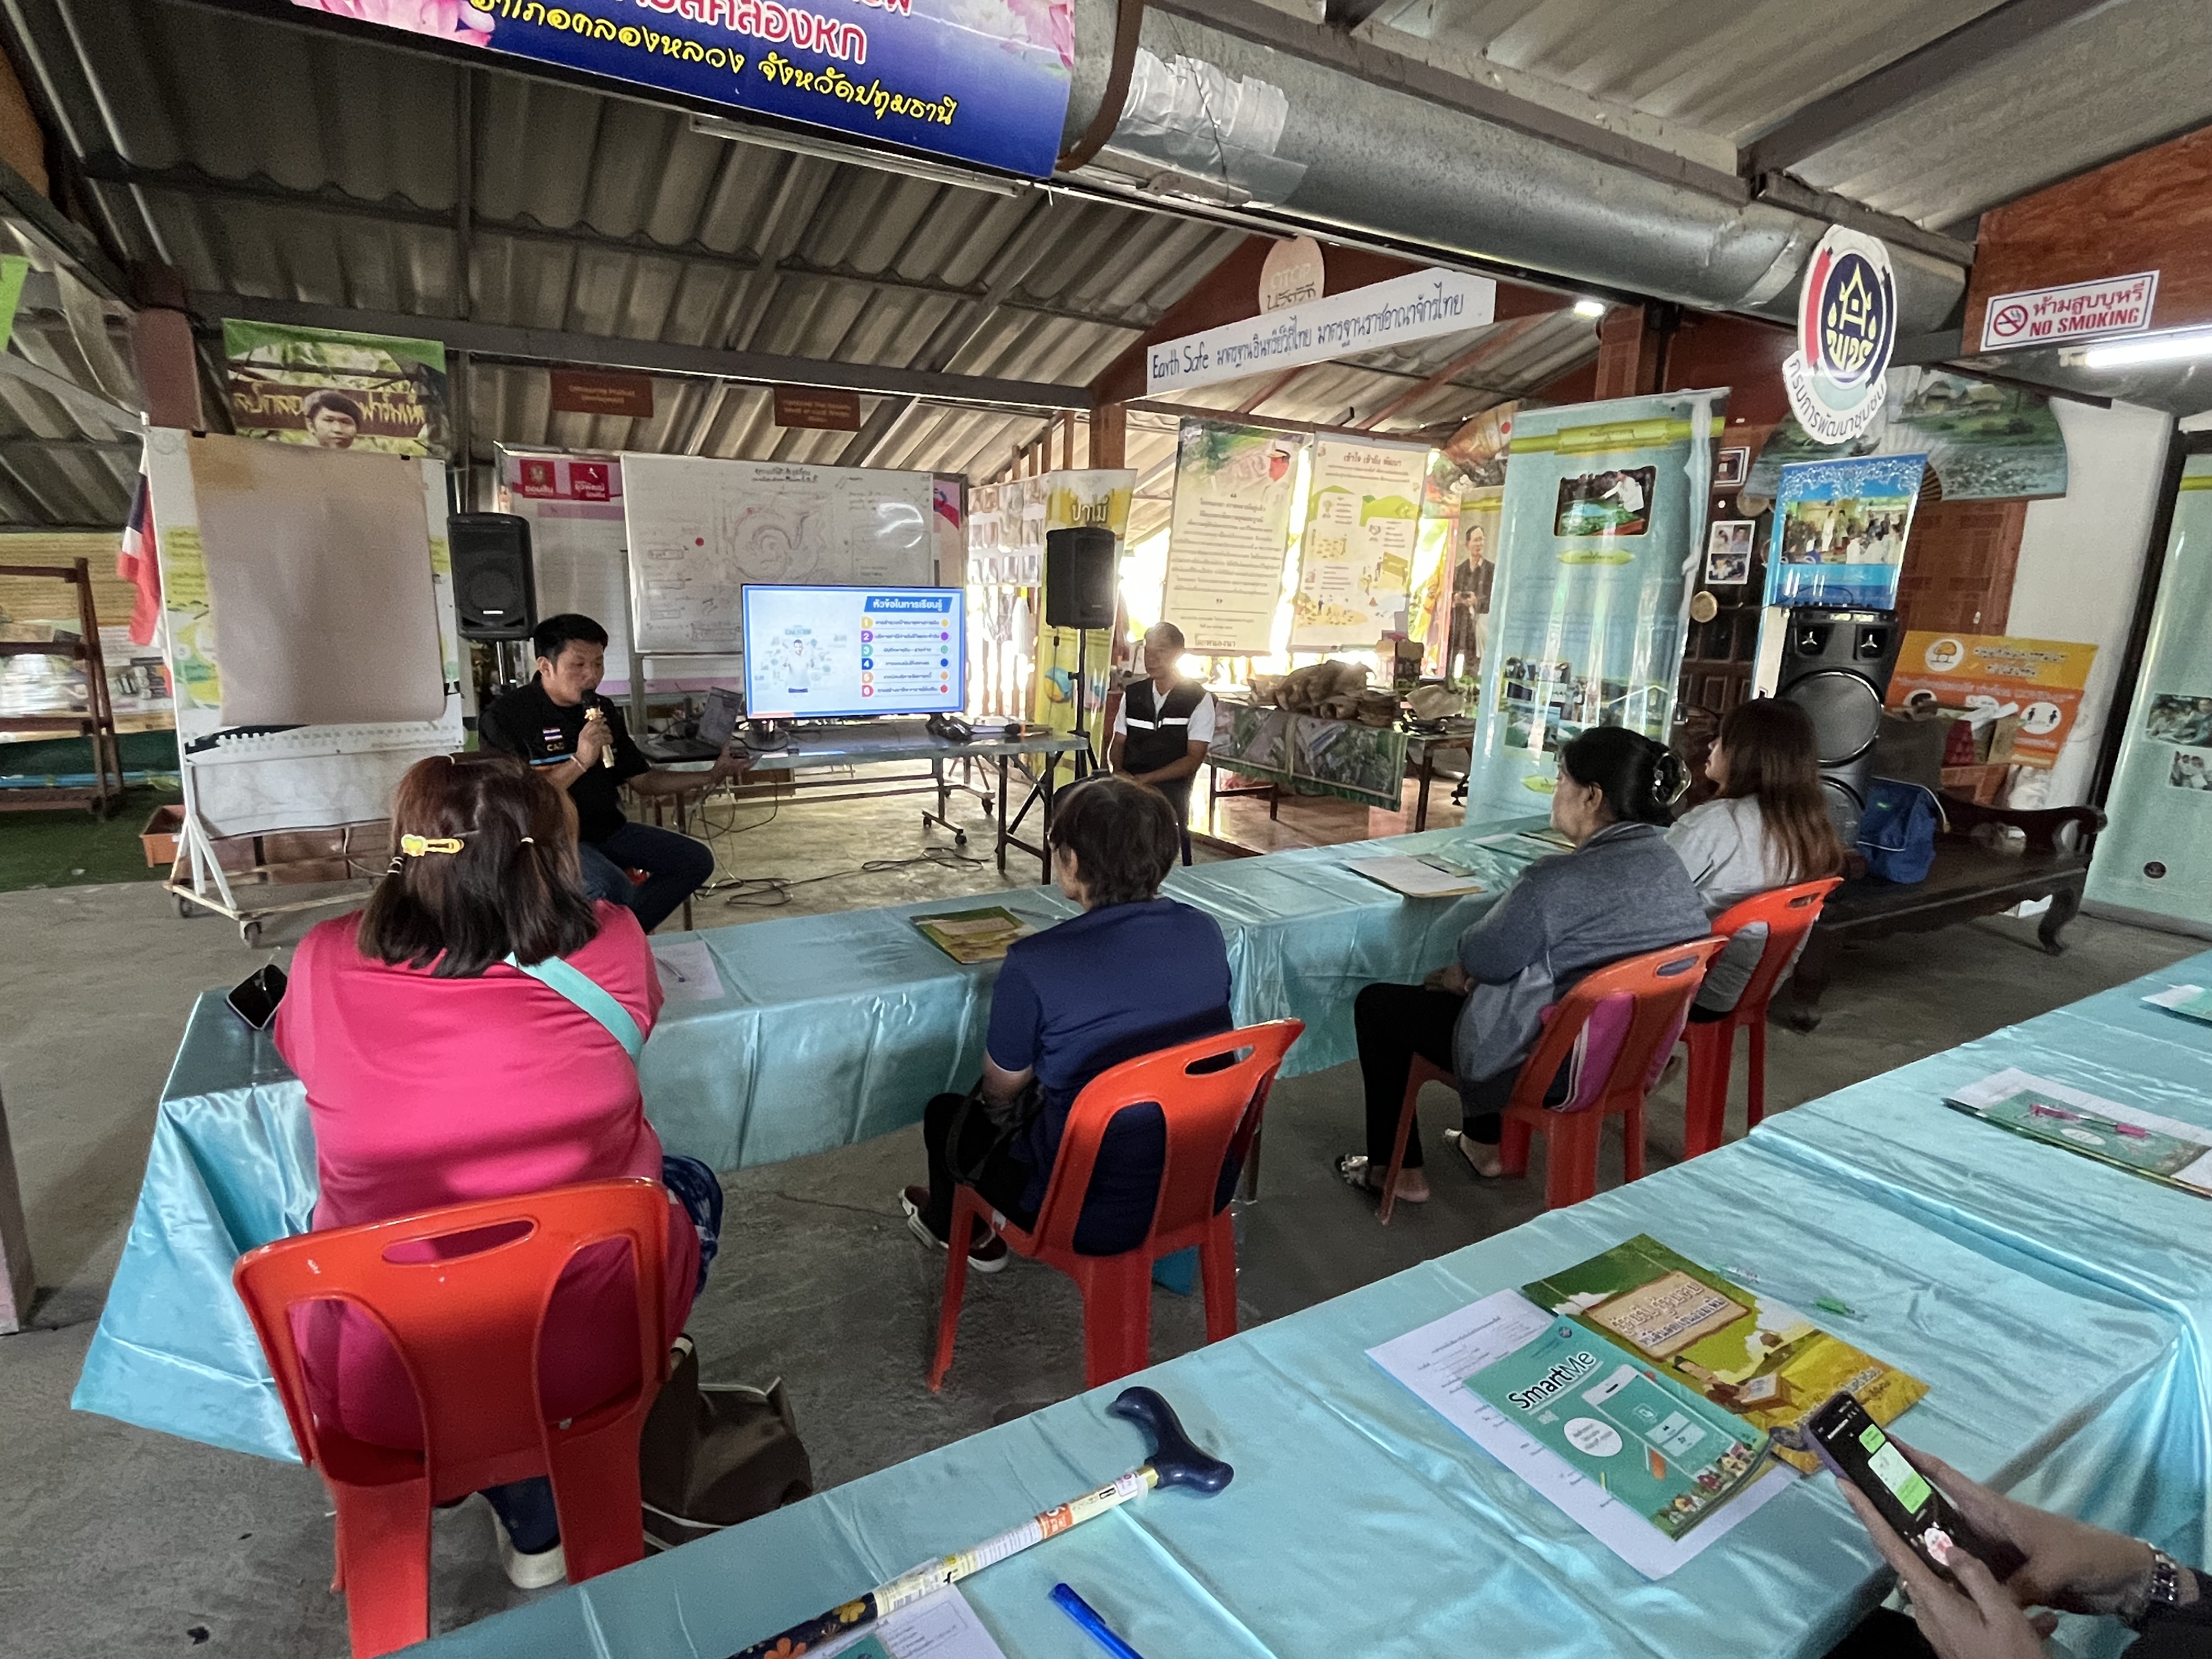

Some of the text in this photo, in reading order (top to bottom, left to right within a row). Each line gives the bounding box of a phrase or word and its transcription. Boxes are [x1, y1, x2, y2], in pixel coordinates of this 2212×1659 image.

[631, 0, 867, 64] ลคลองหก
[758, 52, 958, 125] จังหวัดปทุมธานี
[2029, 307, 2140, 337] NO SMOKING
[2033, 280, 2145, 317] ห้ามสูบบุหรี่
[1153, 348, 1180, 379] Earth
[1183, 341, 1209, 373] Safe
[1507, 1352, 1596, 1410] SmartMe
